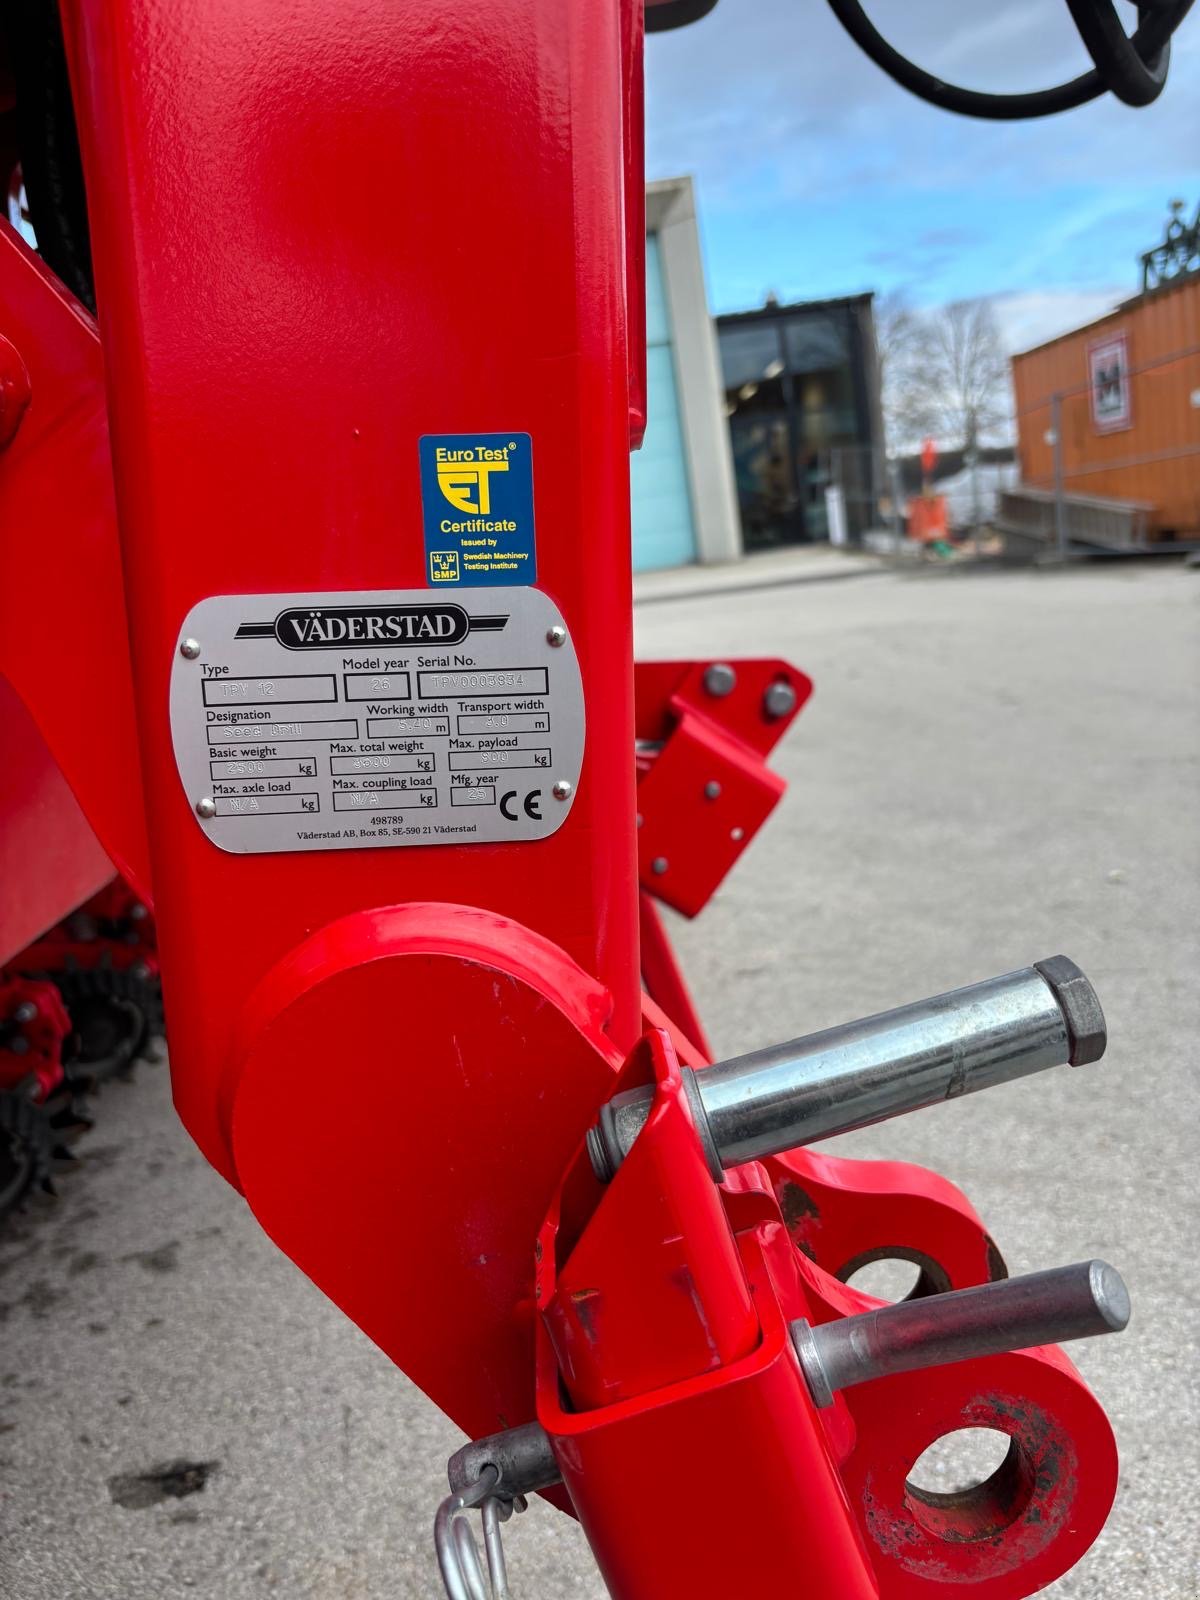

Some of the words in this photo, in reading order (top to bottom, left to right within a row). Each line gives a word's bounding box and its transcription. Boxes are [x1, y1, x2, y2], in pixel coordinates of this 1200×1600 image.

[436, 447, 474, 462] Euro
[440, 519, 516, 533] Certificate
[488, 538, 498, 547] by
[464, 552, 492, 560] Swedish
[494, 552, 528, 560] Machinery
[464, 562, 489, 571] Testing
[434, 570, 456, 580] SMP
[289, 611, 457, 643] VÄDERSTAD
[343, 658, 380, 670] Model
[384, 658, 410, 670] year
[417, 656, 450, 668] Serial
[454, 655, 476, 666] No.
[200, 663, 230, 677] Type
[258, 681, 274, 697] 12
[371, 677, 391, 692] 26
[366, 705, 416, 716] Working
[418, 704, 448, 714] width
[457, 701, 512, 714] Transport
[514, 700, 544, 710] width
[206, 710, 271, 723] Designation
[436, 724, 446, 732] m
[534, 720, 545, 729] m
[223, 726, 262, 738] Seed
[330, 744, 356, 753] Max.
[360, 742, 385, 752] total
[388, 740, 424, 752] weight
[449, 738, 474, 749] Max.
[478, 736, 518, 750] payload
[209, 748, 237, 758] Basic
[240, 746, 276, 758] weight
[417, 758, 430, 770] kg
[534, 754, 547, 765] kg
[298, 763, 312, 776] kg
[332, 779, 359, 789] Max.
[362, 778, 407, 790] coupling
[410, 776, 432, 786] load
[451, 774, 474, 786] Mfg.
[476, 774, 500, 784] year
[212, 784, 239, 794] Max.
[242, 782, 264, 792] axle
[268, 782, 291, 792] load
[302, 798, 315, 810] kg
[420, 794, 433, 805] kg
[500, 790, 542, 821] CE
[370, 816, 404, 826] 498789
[297, 831, 341, 840] Väderstad
[342, 830, 358, 838] AB,
[360, 828, 376, 837] Box
[378, 828, 391, 836] 85,
[392, 827, 420, 836] SE-590
[422, 826, 432, 834] 21
[433, 824, 477, 834] Väderstad
